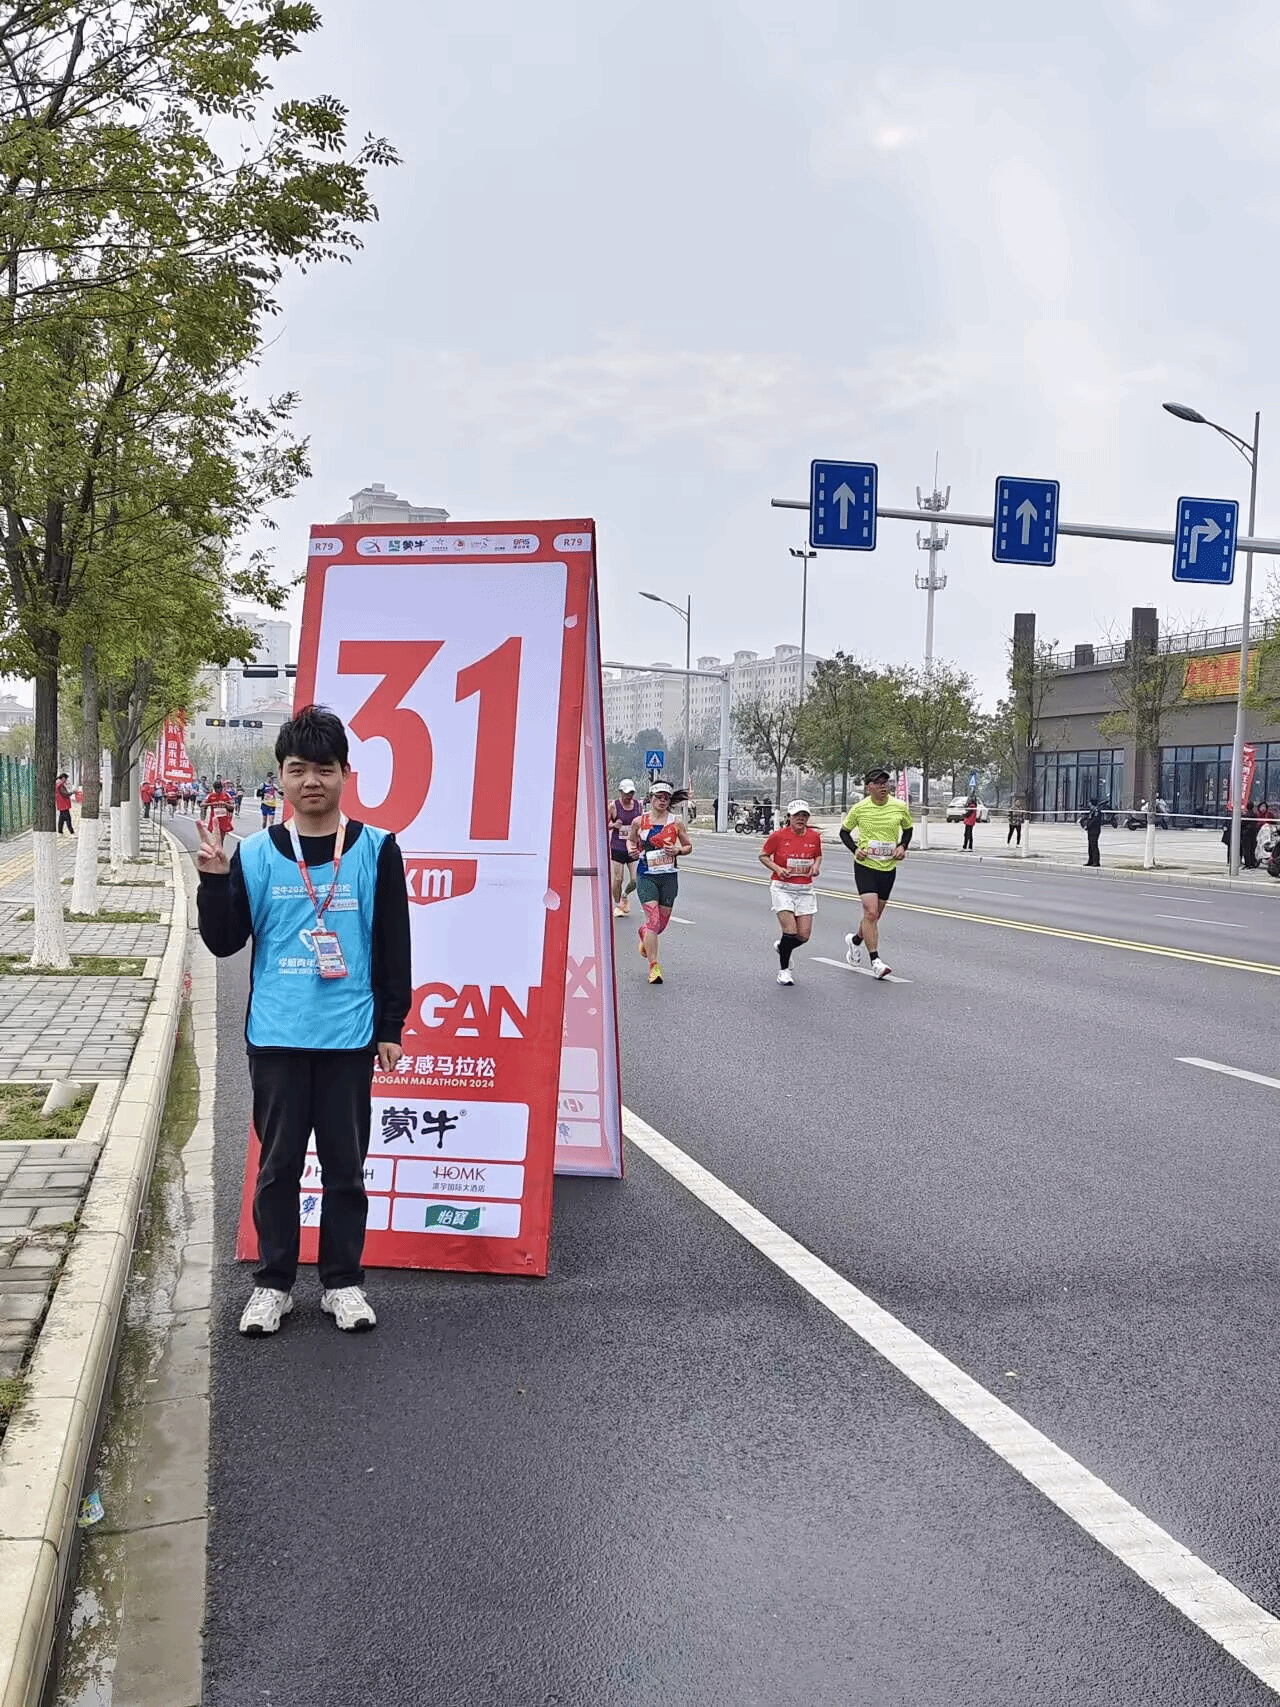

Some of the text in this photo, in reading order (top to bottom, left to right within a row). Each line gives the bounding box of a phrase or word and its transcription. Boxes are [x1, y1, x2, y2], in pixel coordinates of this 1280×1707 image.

[314, 542, 334, 551] R79
[563, 538, 583, 548] R79
[337, 636, 522, 840] 31
[402, 982, 540, 1038] GAN
[374, 1054, 496, 1077] 孝感马拉松
[372, 1075, 494, 1088] AOGAN MARATHON 2024
[381, 1106, 459, 1149] 蒙牛
[432, 1165, 487, 1182] HOMK
